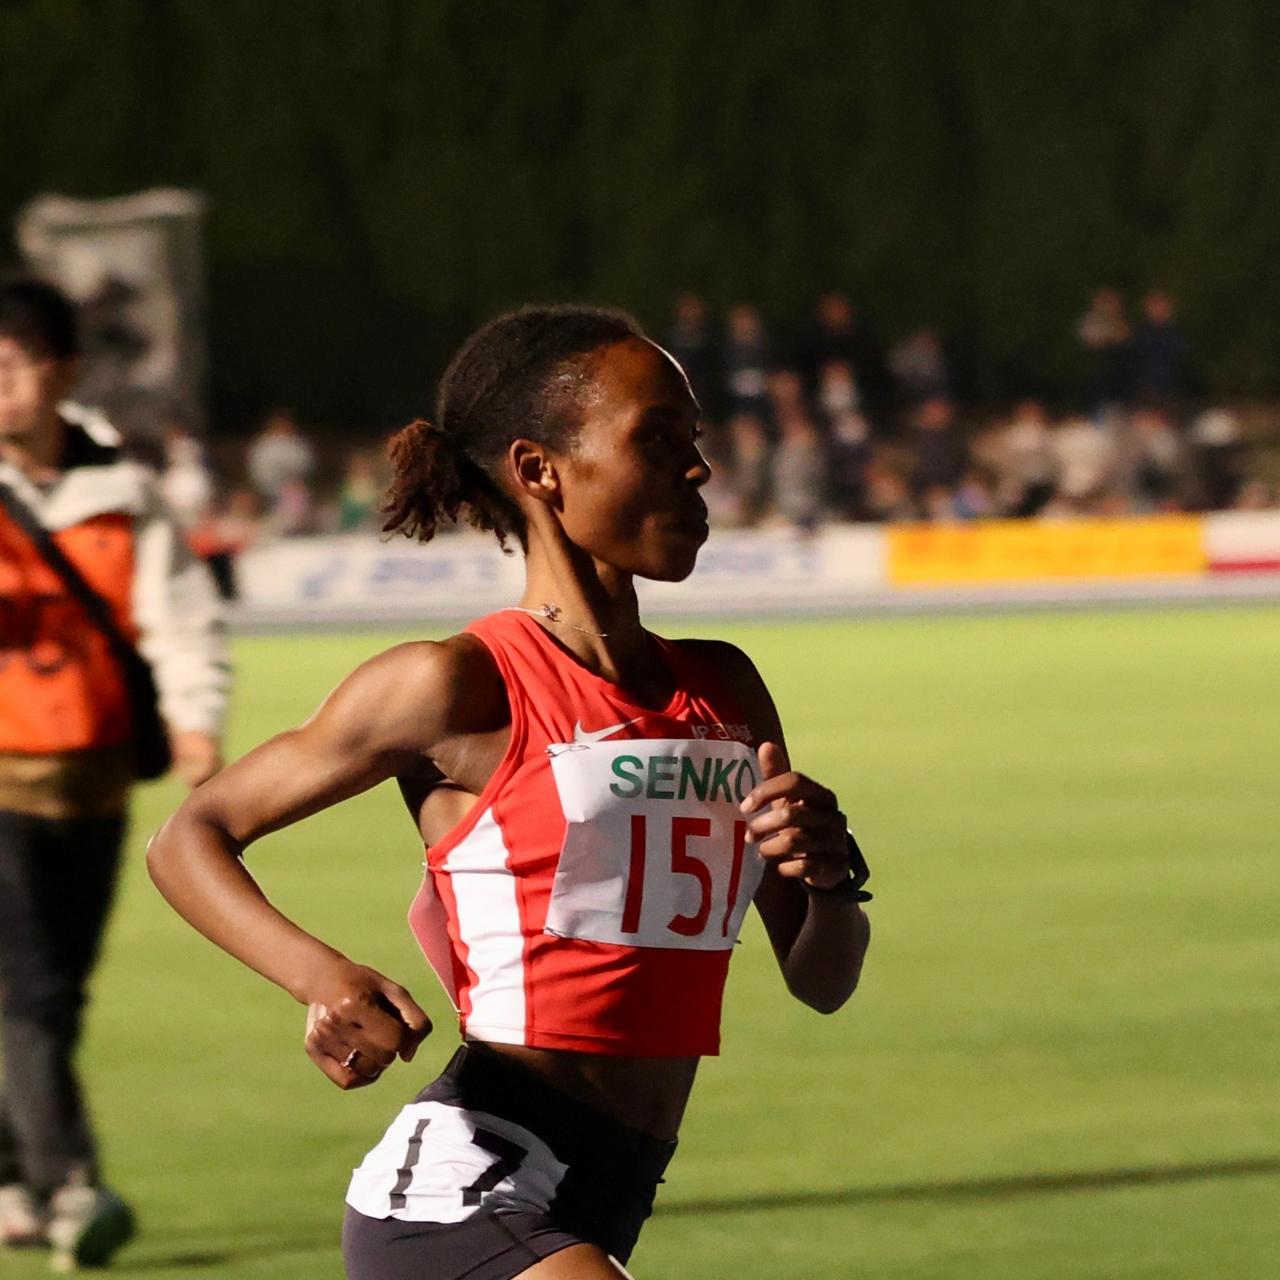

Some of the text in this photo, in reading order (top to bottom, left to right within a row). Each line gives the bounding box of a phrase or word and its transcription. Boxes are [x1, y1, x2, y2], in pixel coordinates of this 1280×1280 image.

[608, 754, 757, 803] SENKO
[620, 814, 747, 937] 151
[389, 1117, 529, 1211] 17
